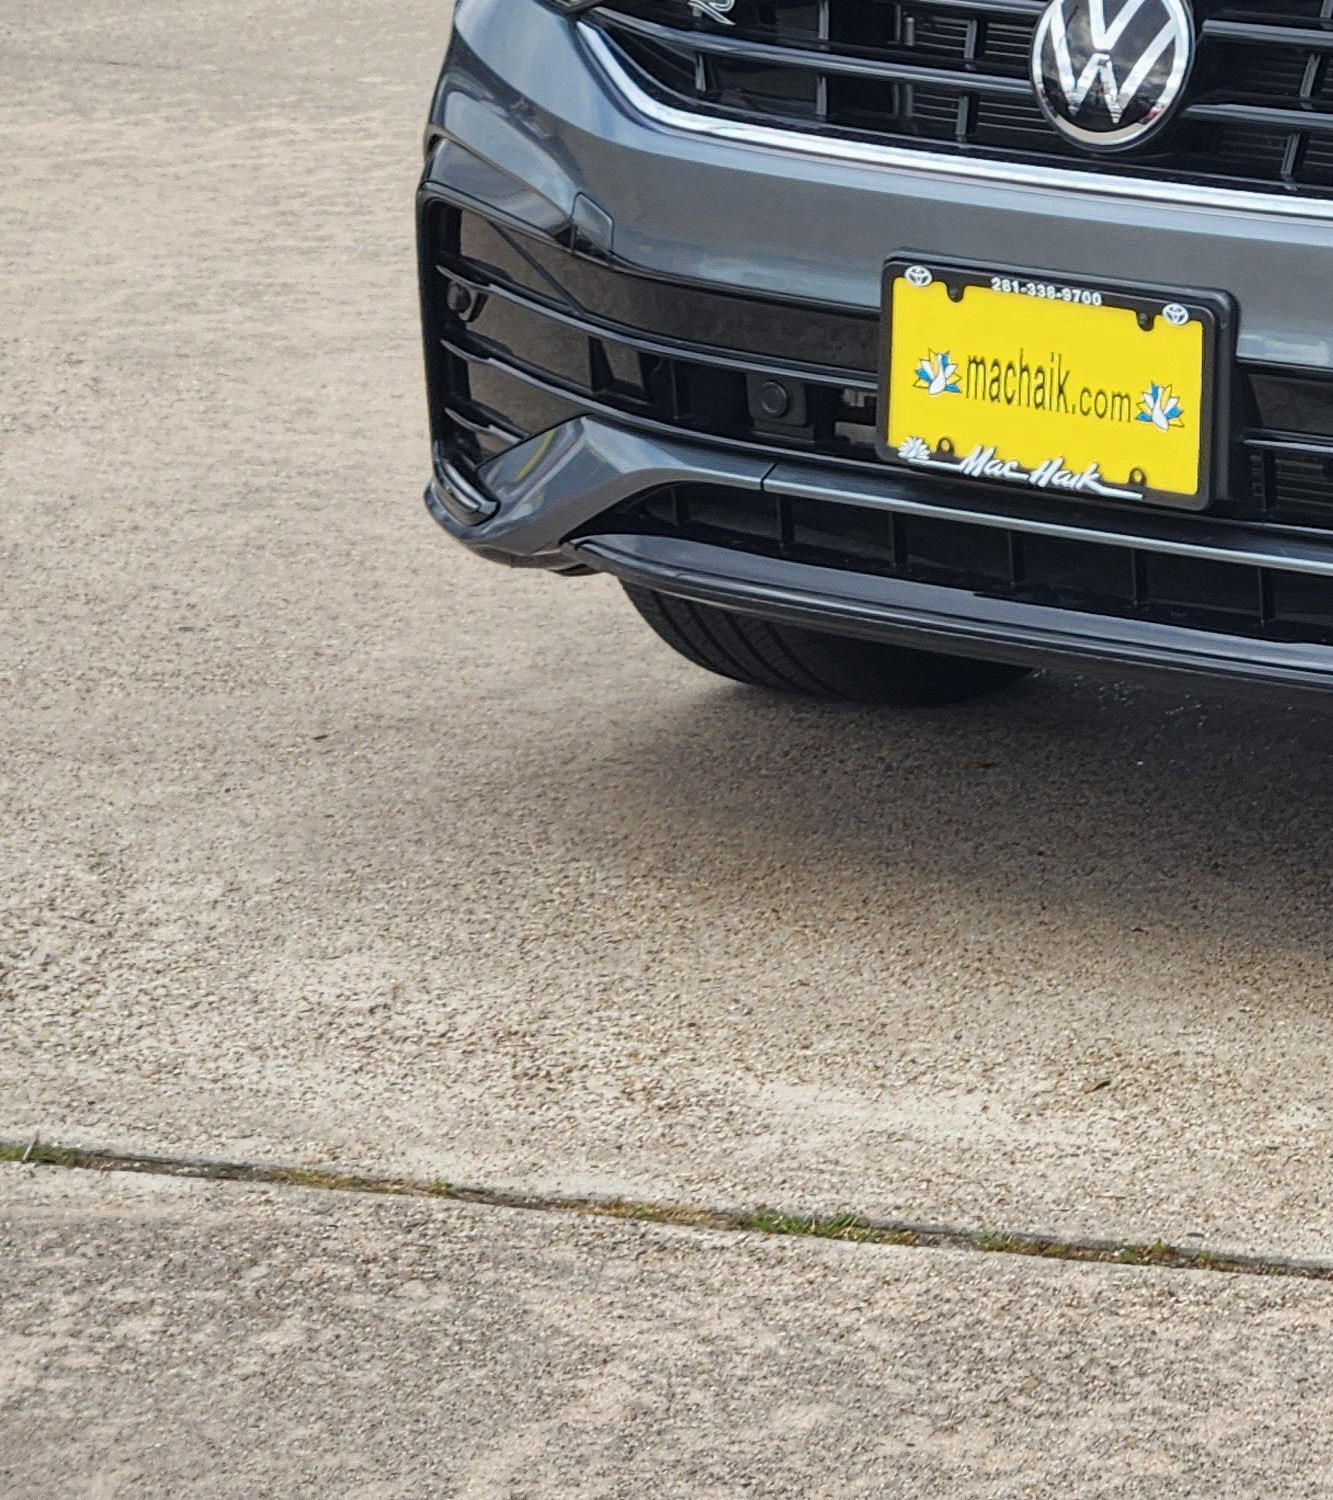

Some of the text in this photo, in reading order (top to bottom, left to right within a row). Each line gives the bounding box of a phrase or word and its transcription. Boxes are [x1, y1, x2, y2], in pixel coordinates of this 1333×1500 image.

[990, 276, 1103, 306] 281-338-9700
[965, 348, 1132, 423] machaik.com
[953, 443, 1029, 478] Mac
